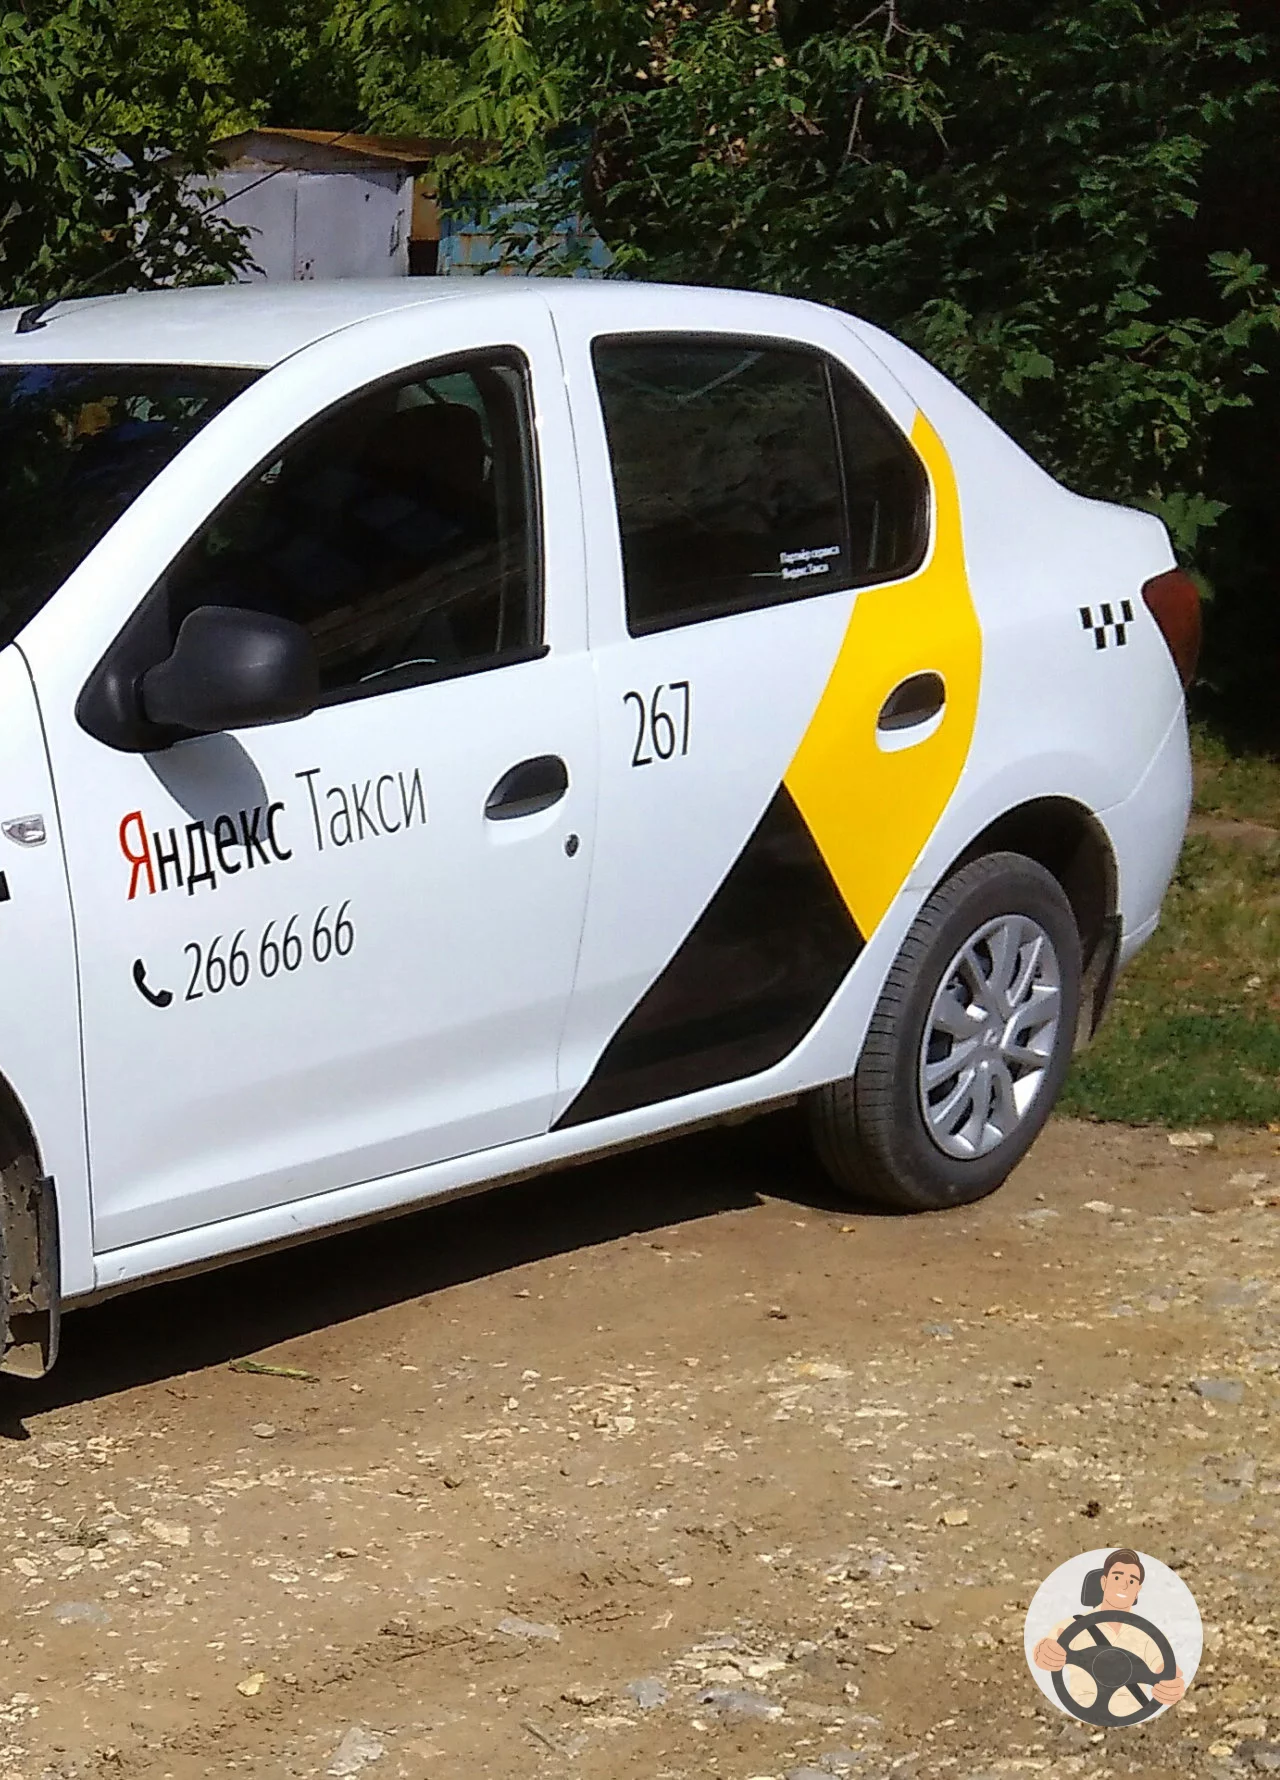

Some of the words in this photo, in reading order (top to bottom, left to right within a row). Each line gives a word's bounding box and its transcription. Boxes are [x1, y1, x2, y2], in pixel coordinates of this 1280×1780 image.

[622, 680, 690, 768] 267
[119, 801, 293, 900] Яндекс
[295, 767, 426, 851] Такси
[184, 929, 250, 1002] 266
[259, 914, 302, 978] 66
[312, 899, 354, 963] 66
